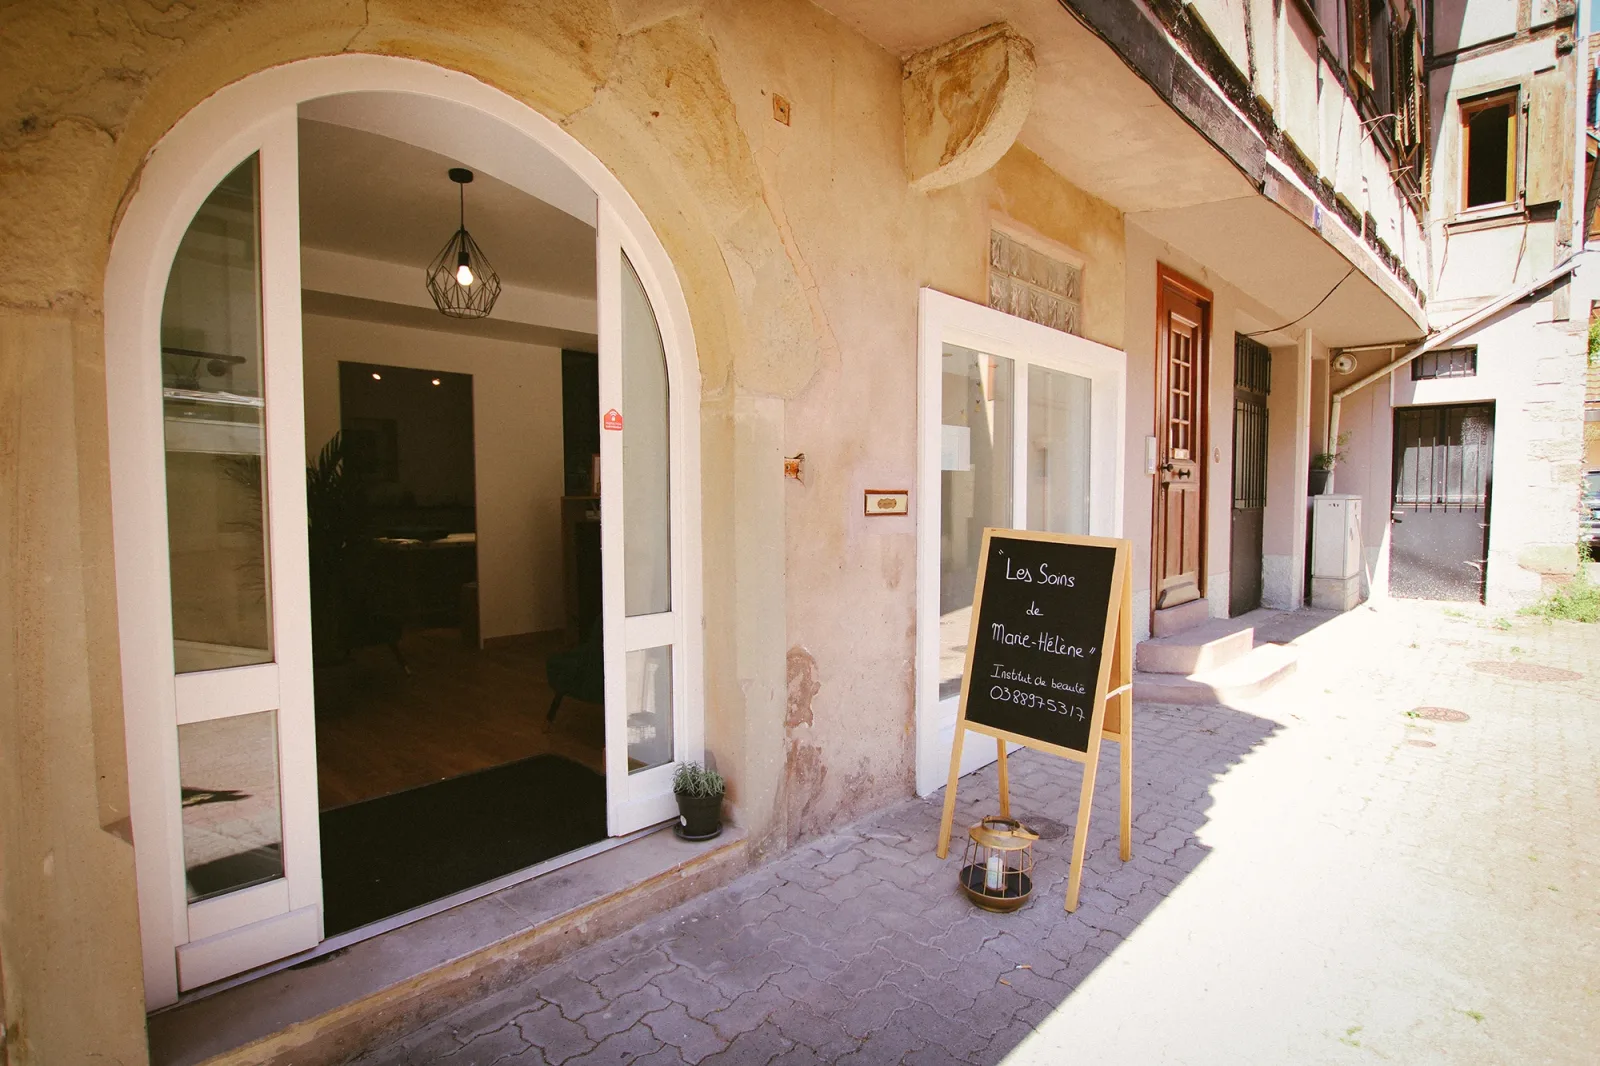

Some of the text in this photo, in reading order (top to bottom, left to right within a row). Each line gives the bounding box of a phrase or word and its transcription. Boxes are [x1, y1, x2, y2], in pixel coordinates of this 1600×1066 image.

[1037, 562, 1076, 588] Soins
[1026, 600, 1044, 616] de
[990, 663, 1087, 695] Institut de beauté
